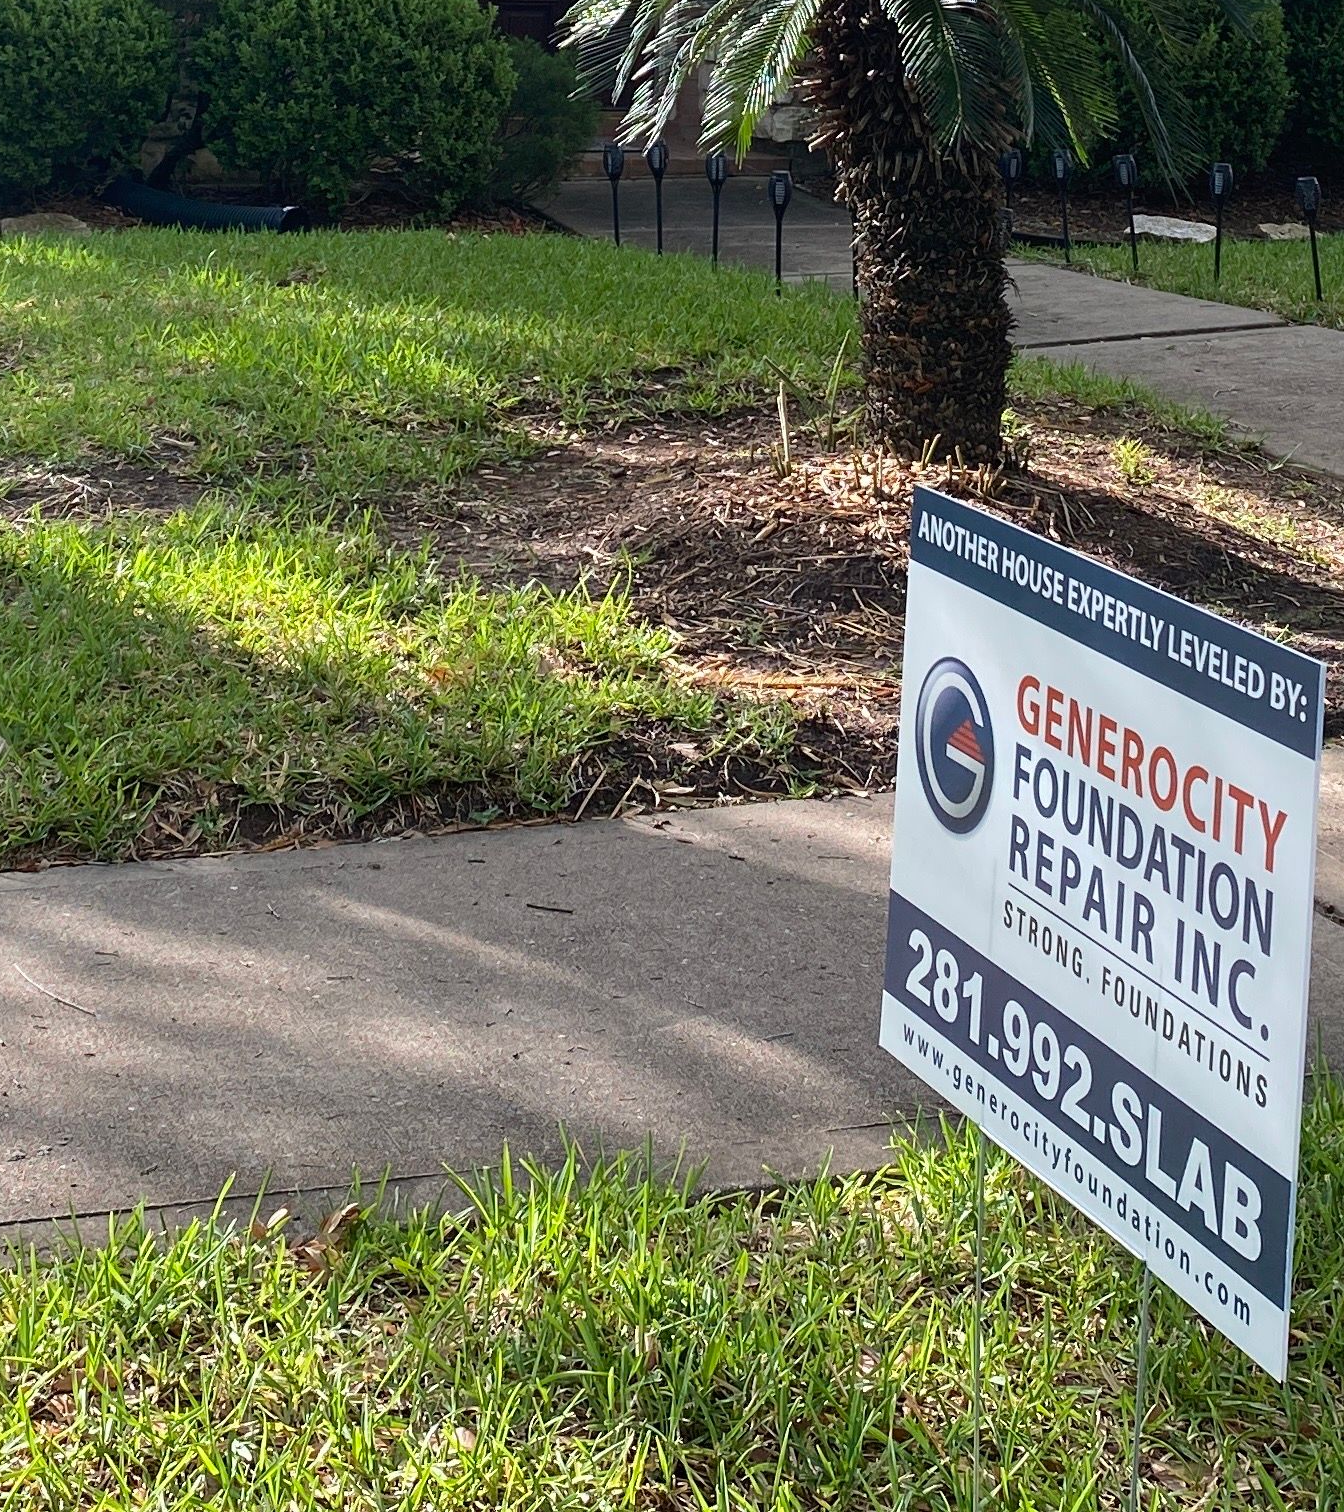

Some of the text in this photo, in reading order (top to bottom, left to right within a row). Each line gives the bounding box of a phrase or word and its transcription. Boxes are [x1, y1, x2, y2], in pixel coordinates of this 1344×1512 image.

[918, 510, 1308, 723] ANOTHER HOUSE EXPERTLY LEVELED BY:
[1013, 742, 1274, 958] FOUNDATION
[1015, 674, 1288, 873] GENEROCITY
[1003, 899, 1269, 1109] STRONG. FOUNDATIONS
[1009, 814, 1270, 1042] REPAIR INC.
[903, 1023, 1252, 1327] www.generocityfoundation.com
[905, 928, 1263, 1263] 281.992.SLAB
